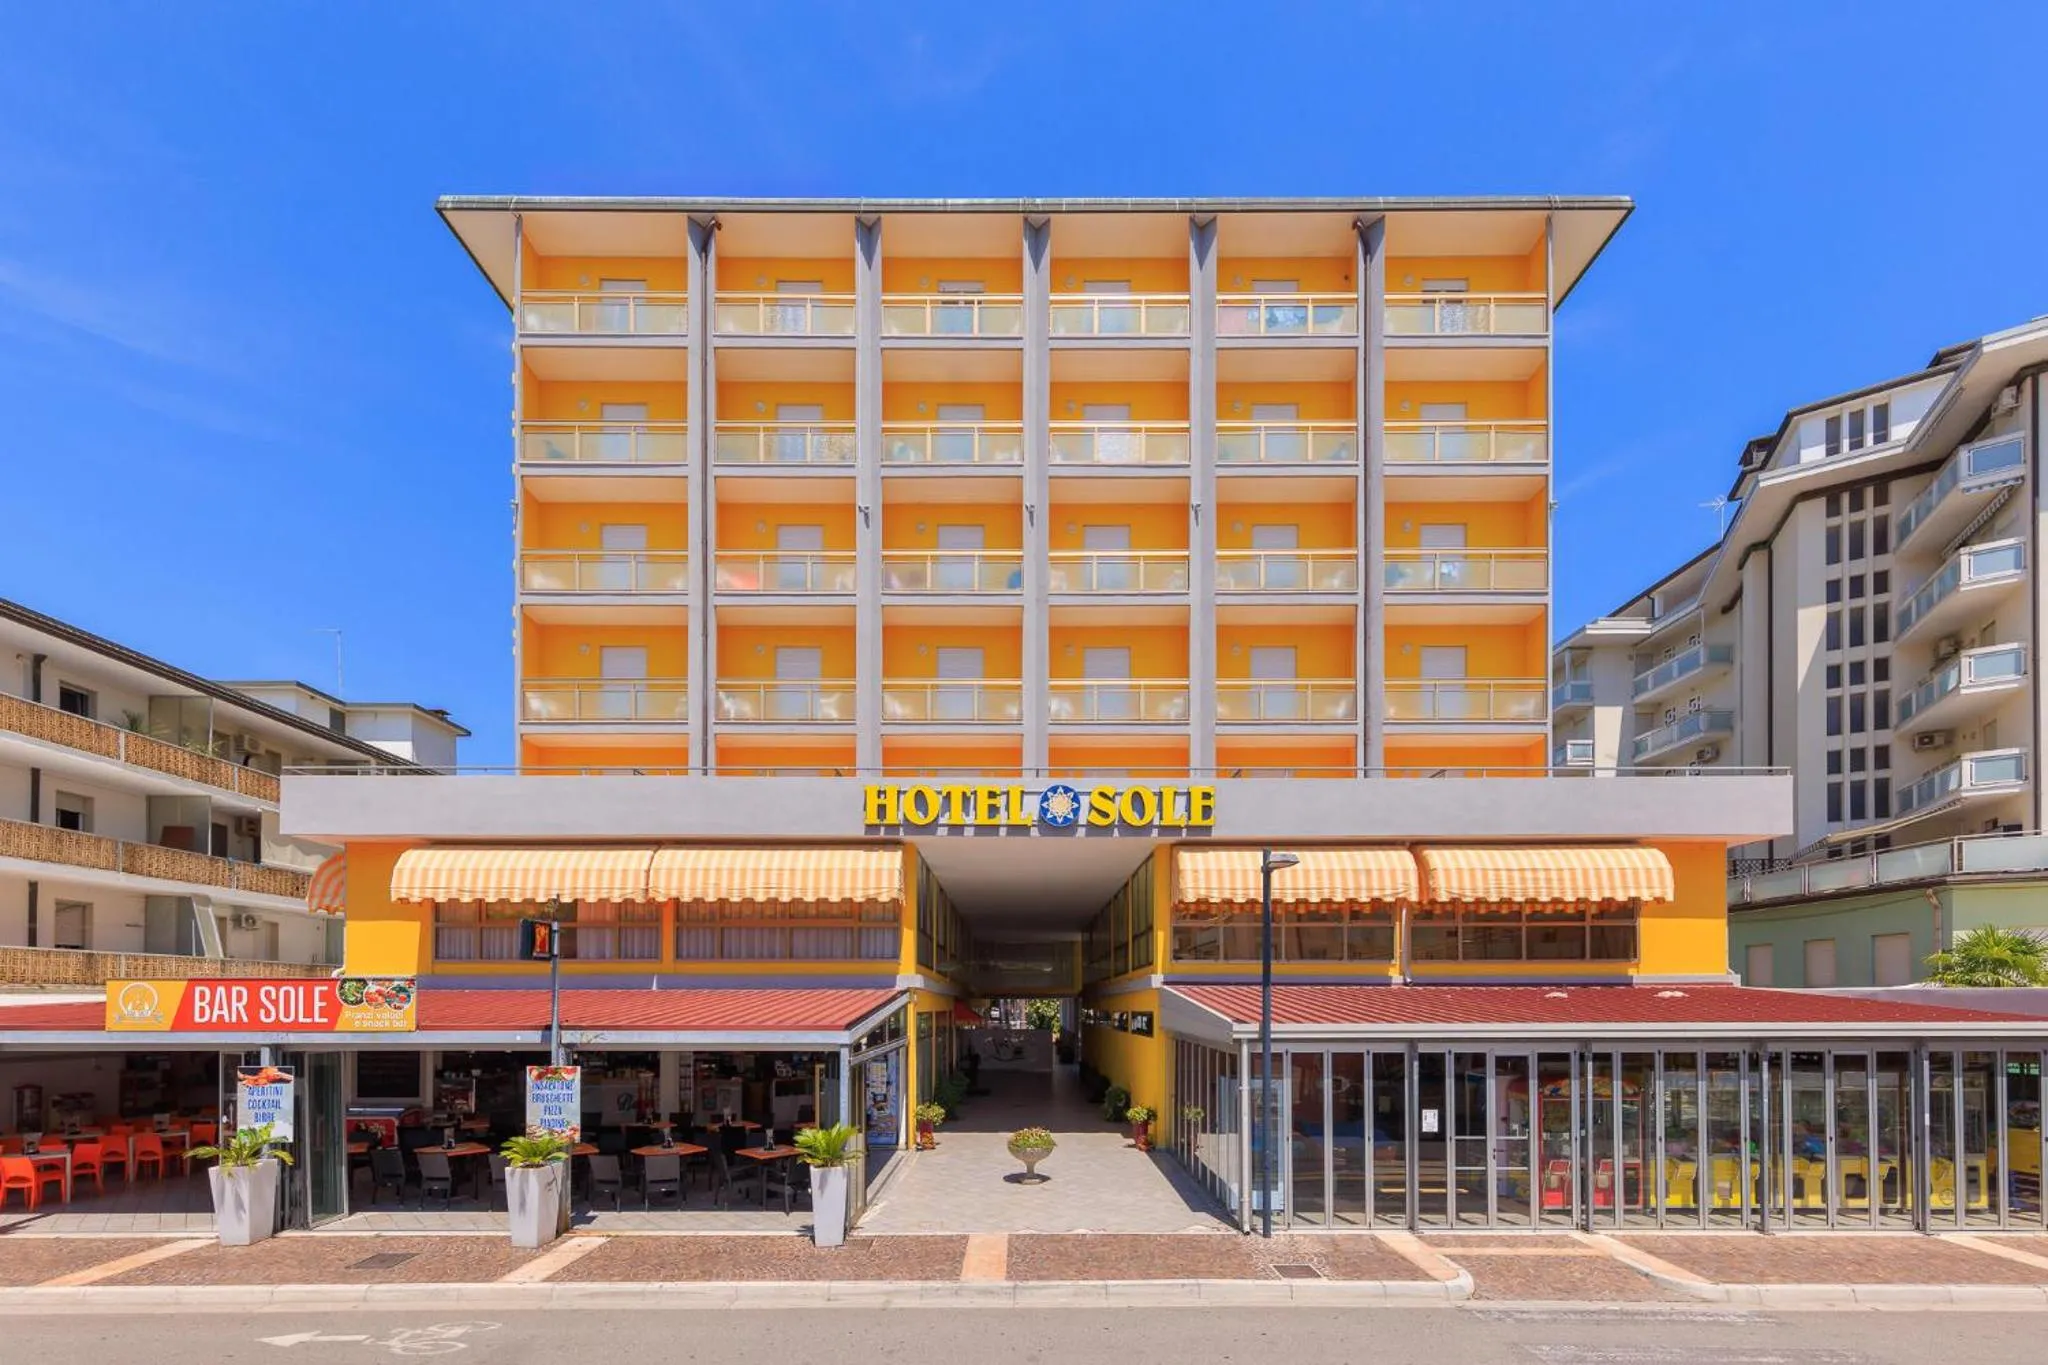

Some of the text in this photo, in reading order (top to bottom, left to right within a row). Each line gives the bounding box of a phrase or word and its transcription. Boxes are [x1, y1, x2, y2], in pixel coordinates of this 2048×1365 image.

[864, 784, 1216, 828] HOTEL SOLE
[193, 986, 329, 1024] BAR SOLE
[532, 1093, 573, 1103] BRUSCHETTE
[248, 1099, 281, 1110] COCKTAIL
[543, 1105, 562, 1116] PIZZA
[254, 1112, 275, 1123] BIRRE
